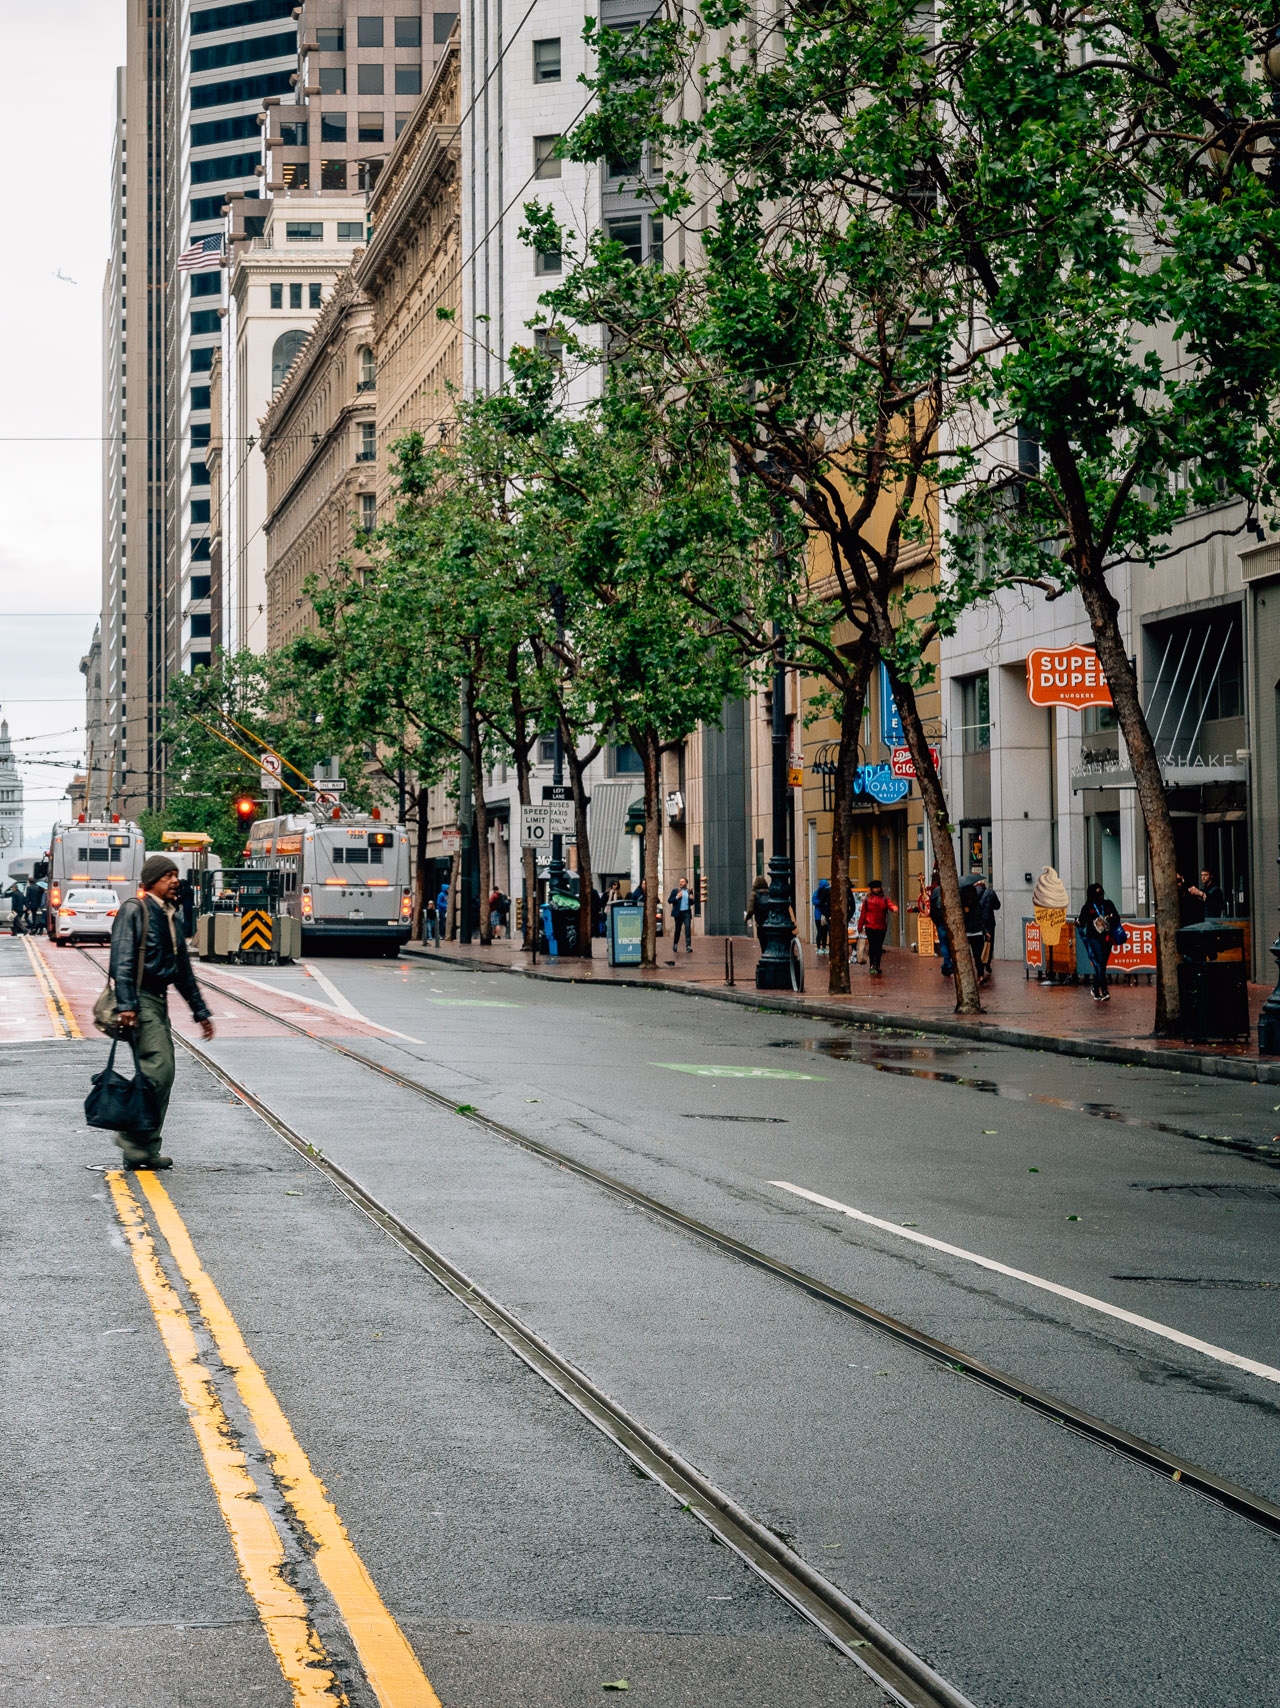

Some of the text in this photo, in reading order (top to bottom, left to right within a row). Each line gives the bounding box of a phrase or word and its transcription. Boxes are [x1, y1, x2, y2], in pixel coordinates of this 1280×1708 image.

[1040, 656, 1104, 671] SUPE
[870, 781, 905, 791] OASIS
[526, 825, 545, 839] 10
[376, 833, 384, 844] 5
[1027, 928, 1040, 939] SUPER
[1027, 940, 1040, 951] DUPER
